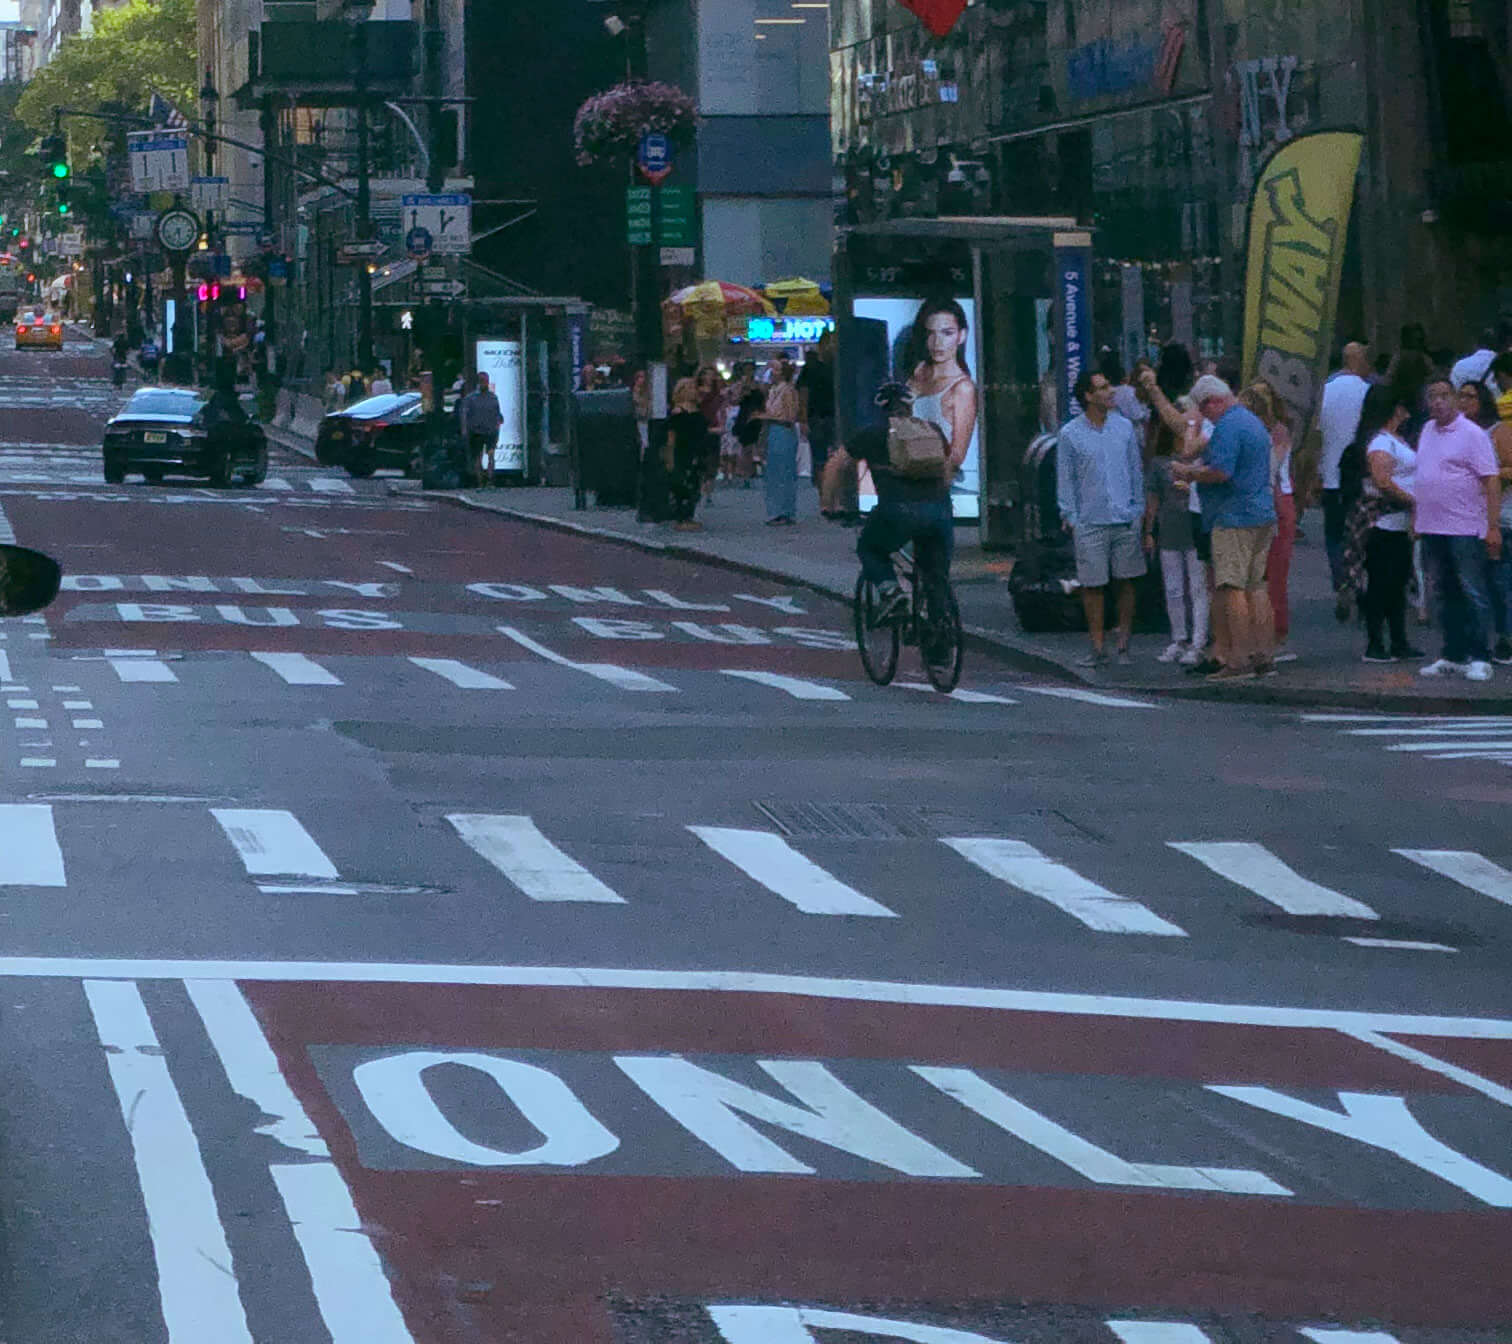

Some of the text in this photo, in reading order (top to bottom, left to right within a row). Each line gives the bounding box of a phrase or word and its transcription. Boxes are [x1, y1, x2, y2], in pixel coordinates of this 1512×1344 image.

[1064, 271, 1080, 281] 5
[1064, 284, 1080, 338] Avenue
[60, 574, 808, 615] ONLY ONLY
[115, 602, 860, 650] BUS BUS
[352, 1050, 1512, 1208] ONLY
